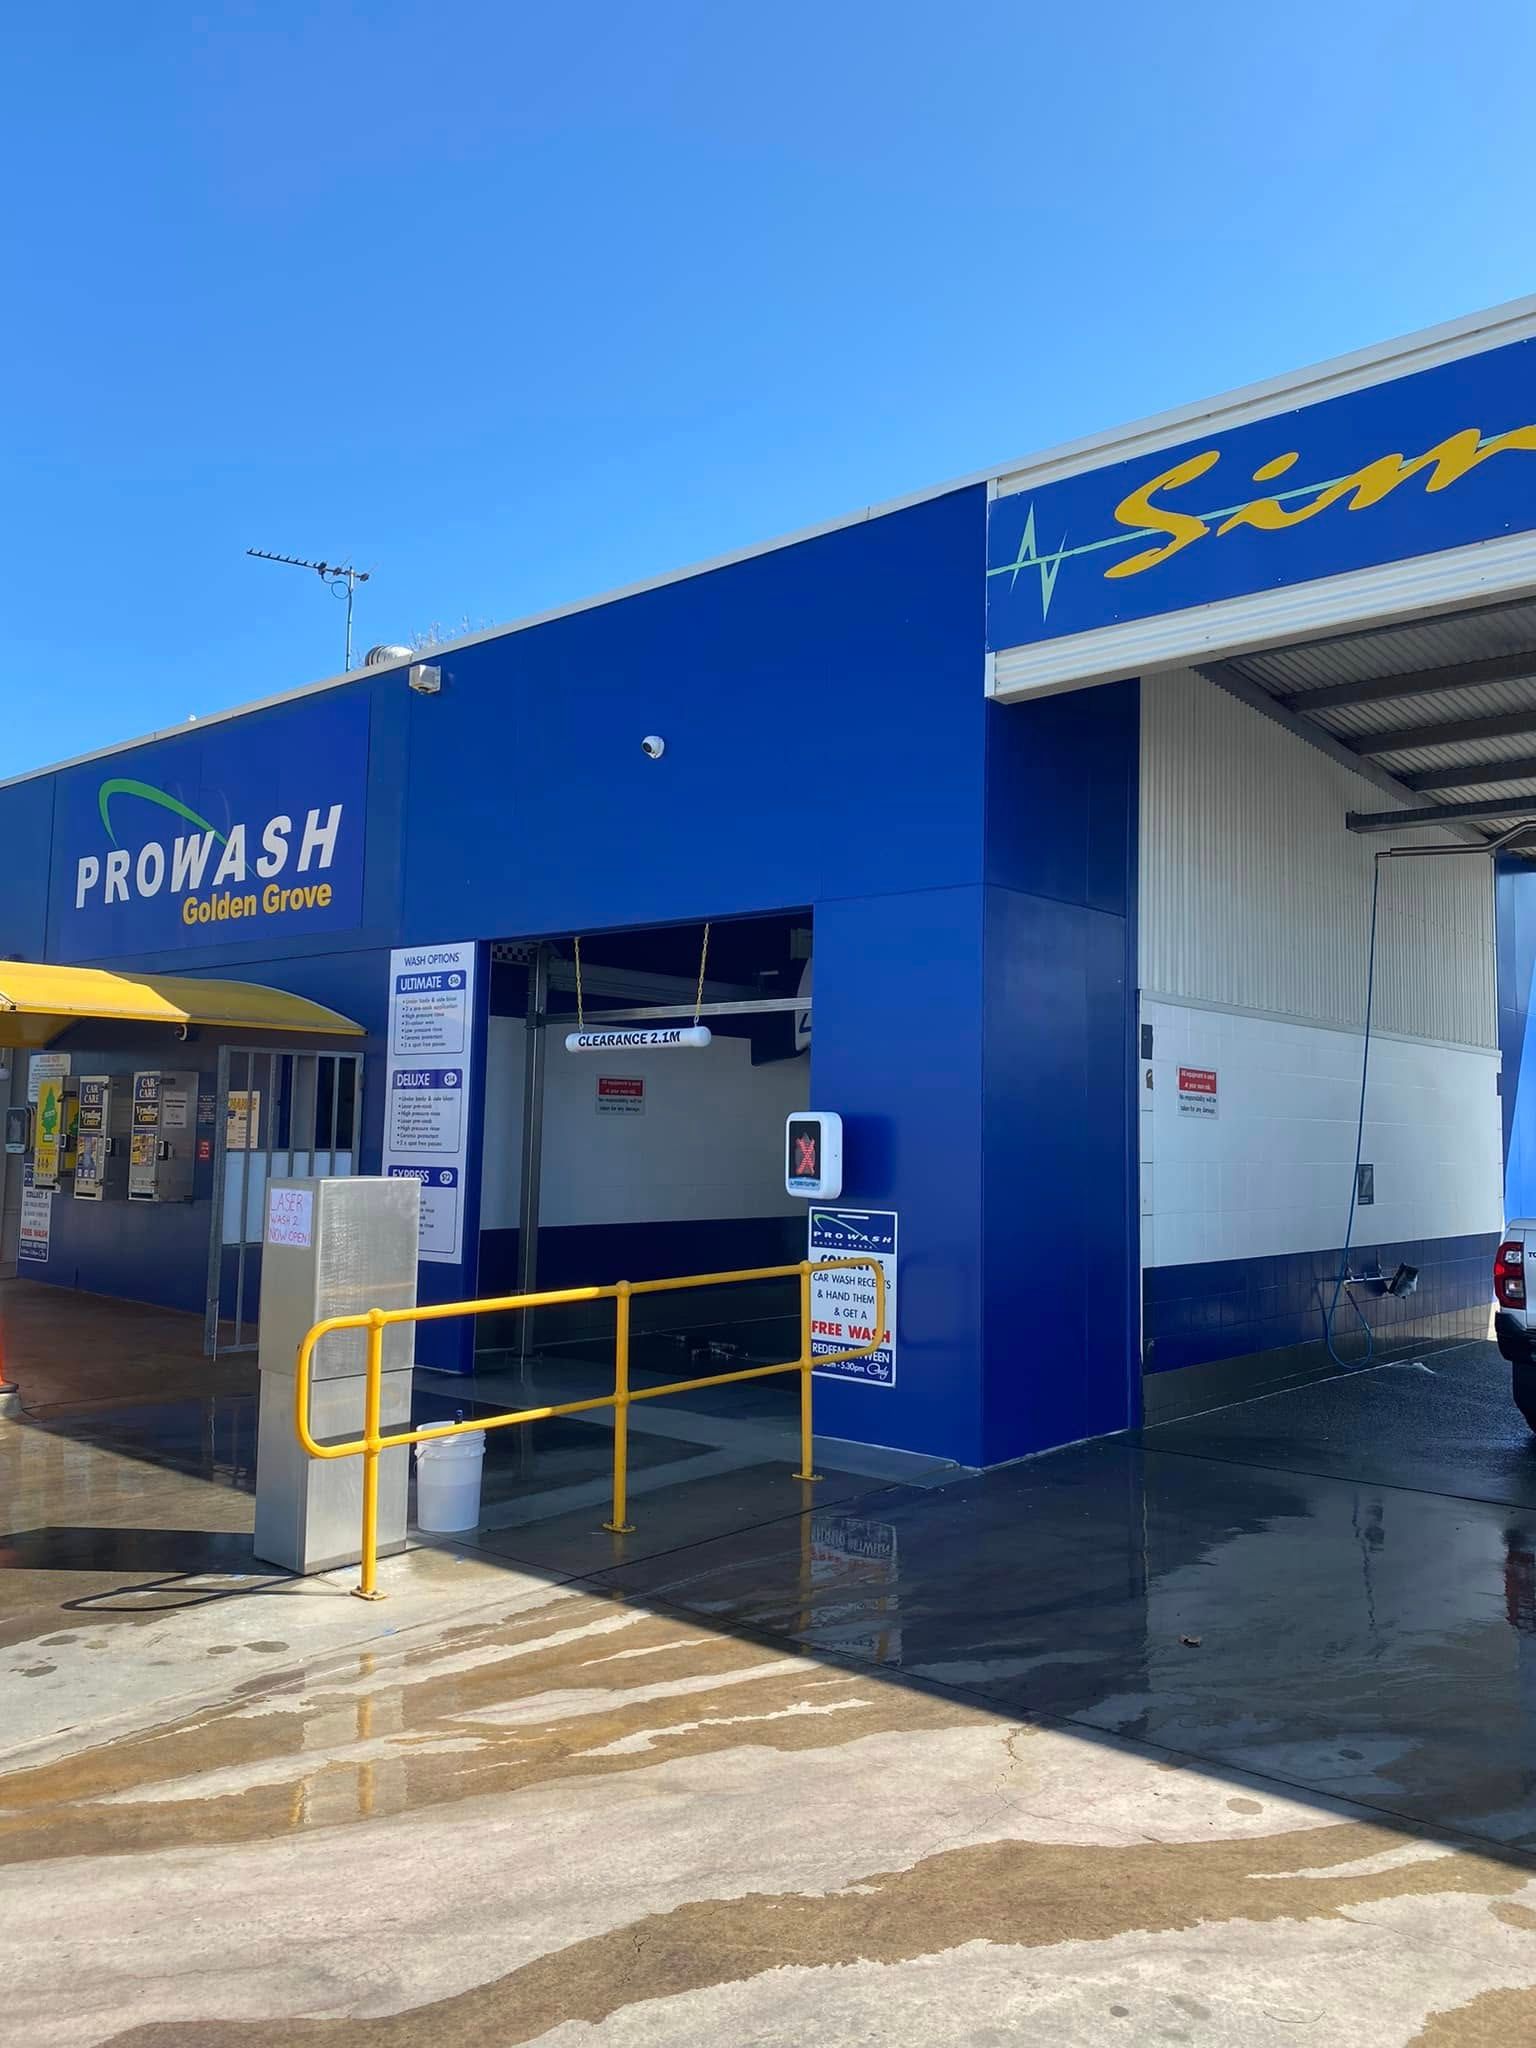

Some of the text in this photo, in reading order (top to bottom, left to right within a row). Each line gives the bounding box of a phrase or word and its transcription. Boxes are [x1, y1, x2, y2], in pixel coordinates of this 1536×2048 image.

[76, 804, 343, 909] PROWASH
[182, 883, 332, 925] Golden Grove
[404, 952, 460, 966] WASH OPTIONS
[400, 976, 442, 991] ULTIMATE
[578, 1031, 681, 1047] CLEARANCE 2.1M
[397, 1073, 430, 1086] DELUXE
[84, 1094, 100, 1104] CARE
[140, 1088, 157, 1098] CARE
[271, 1192, 304, 1212] LASER
[271, 1215, 290, 1225] WASH
[270, 1228, 288, 1241] NOW
[813, 1272, 892, 1290] CAR WASH RECES
[817, 1289, 874, 1304] & HAND THEM
[834, 1307, 868, 1320] & GET A
[812, 1320, 842, 1336] FREE
[840, 1361, 864, 1373] 5.30pm
